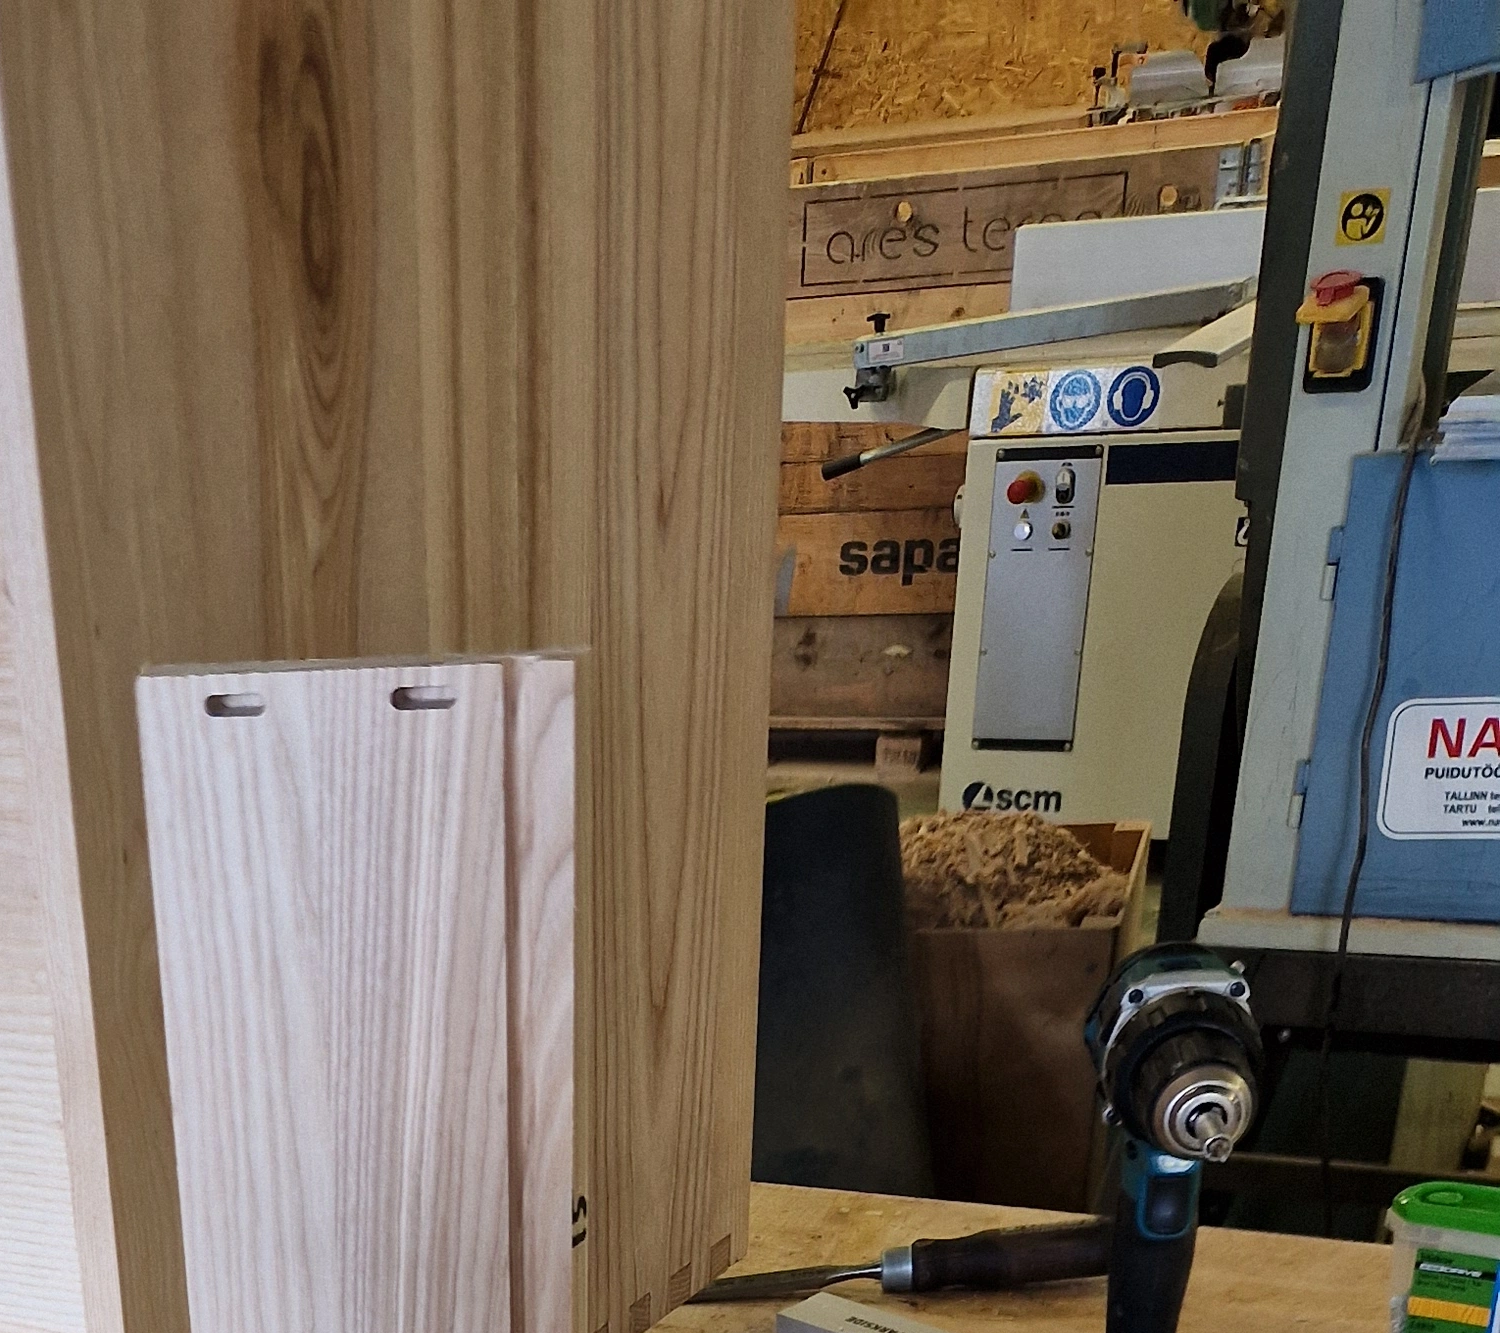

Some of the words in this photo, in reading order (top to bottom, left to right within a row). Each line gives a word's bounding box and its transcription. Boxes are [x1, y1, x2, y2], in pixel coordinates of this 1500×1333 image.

[838, 537, 960, 587] sapa
[995, 788, 1062, 812] scm
[1444, 790, 1488, 801] TALLINN
[1443, 803, 1477, 814] TARTU
